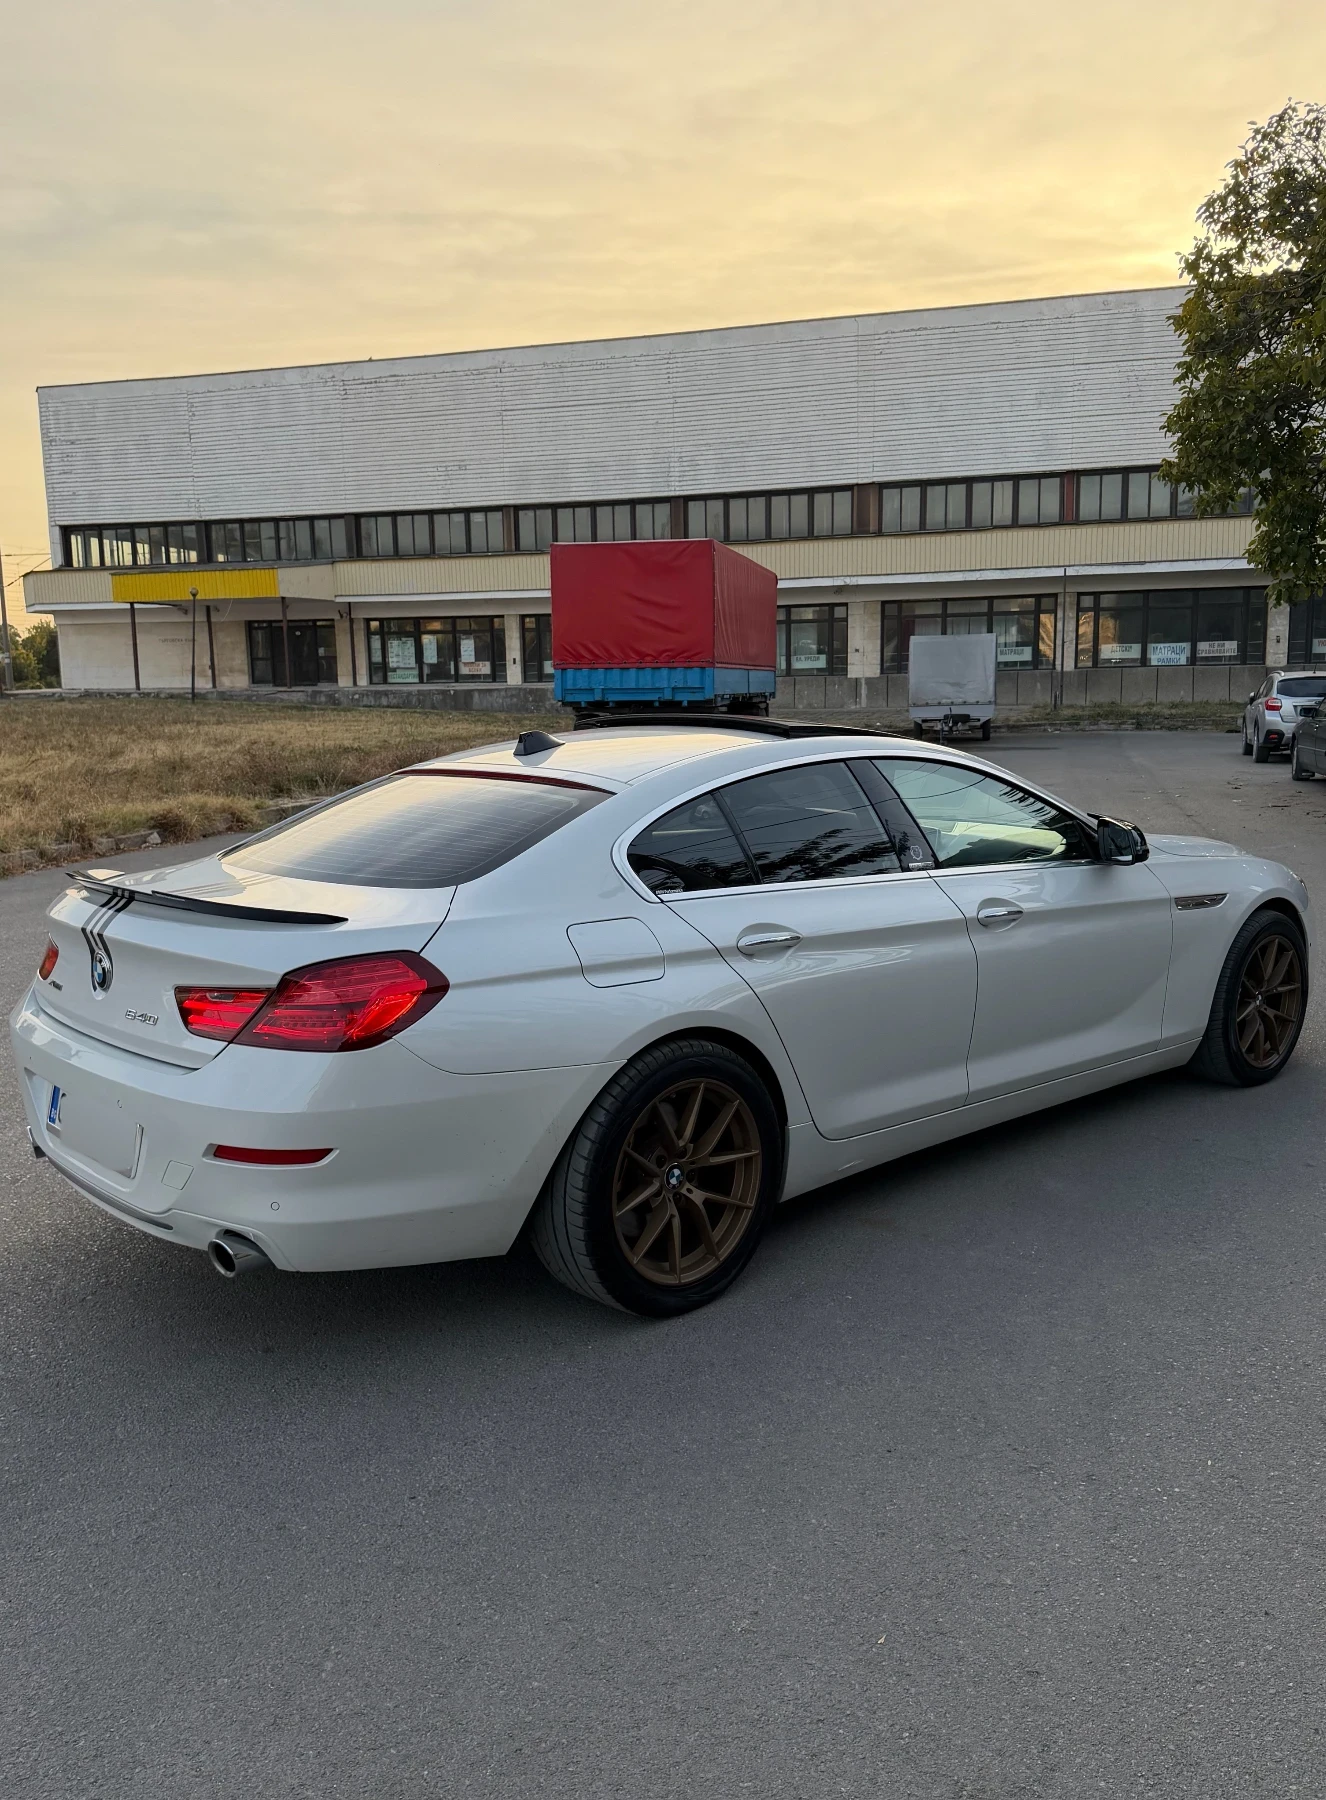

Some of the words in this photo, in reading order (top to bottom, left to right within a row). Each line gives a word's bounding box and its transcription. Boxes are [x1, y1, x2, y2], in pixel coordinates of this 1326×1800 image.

[999, 648, 1024, 656] МАТРАЦИ
[1111, 645, 1133, 654] ДЕТСКИ
[1152, 645, 1186, 656] МАТРАЦИ
[125, 1008, 158, 1026] 640
